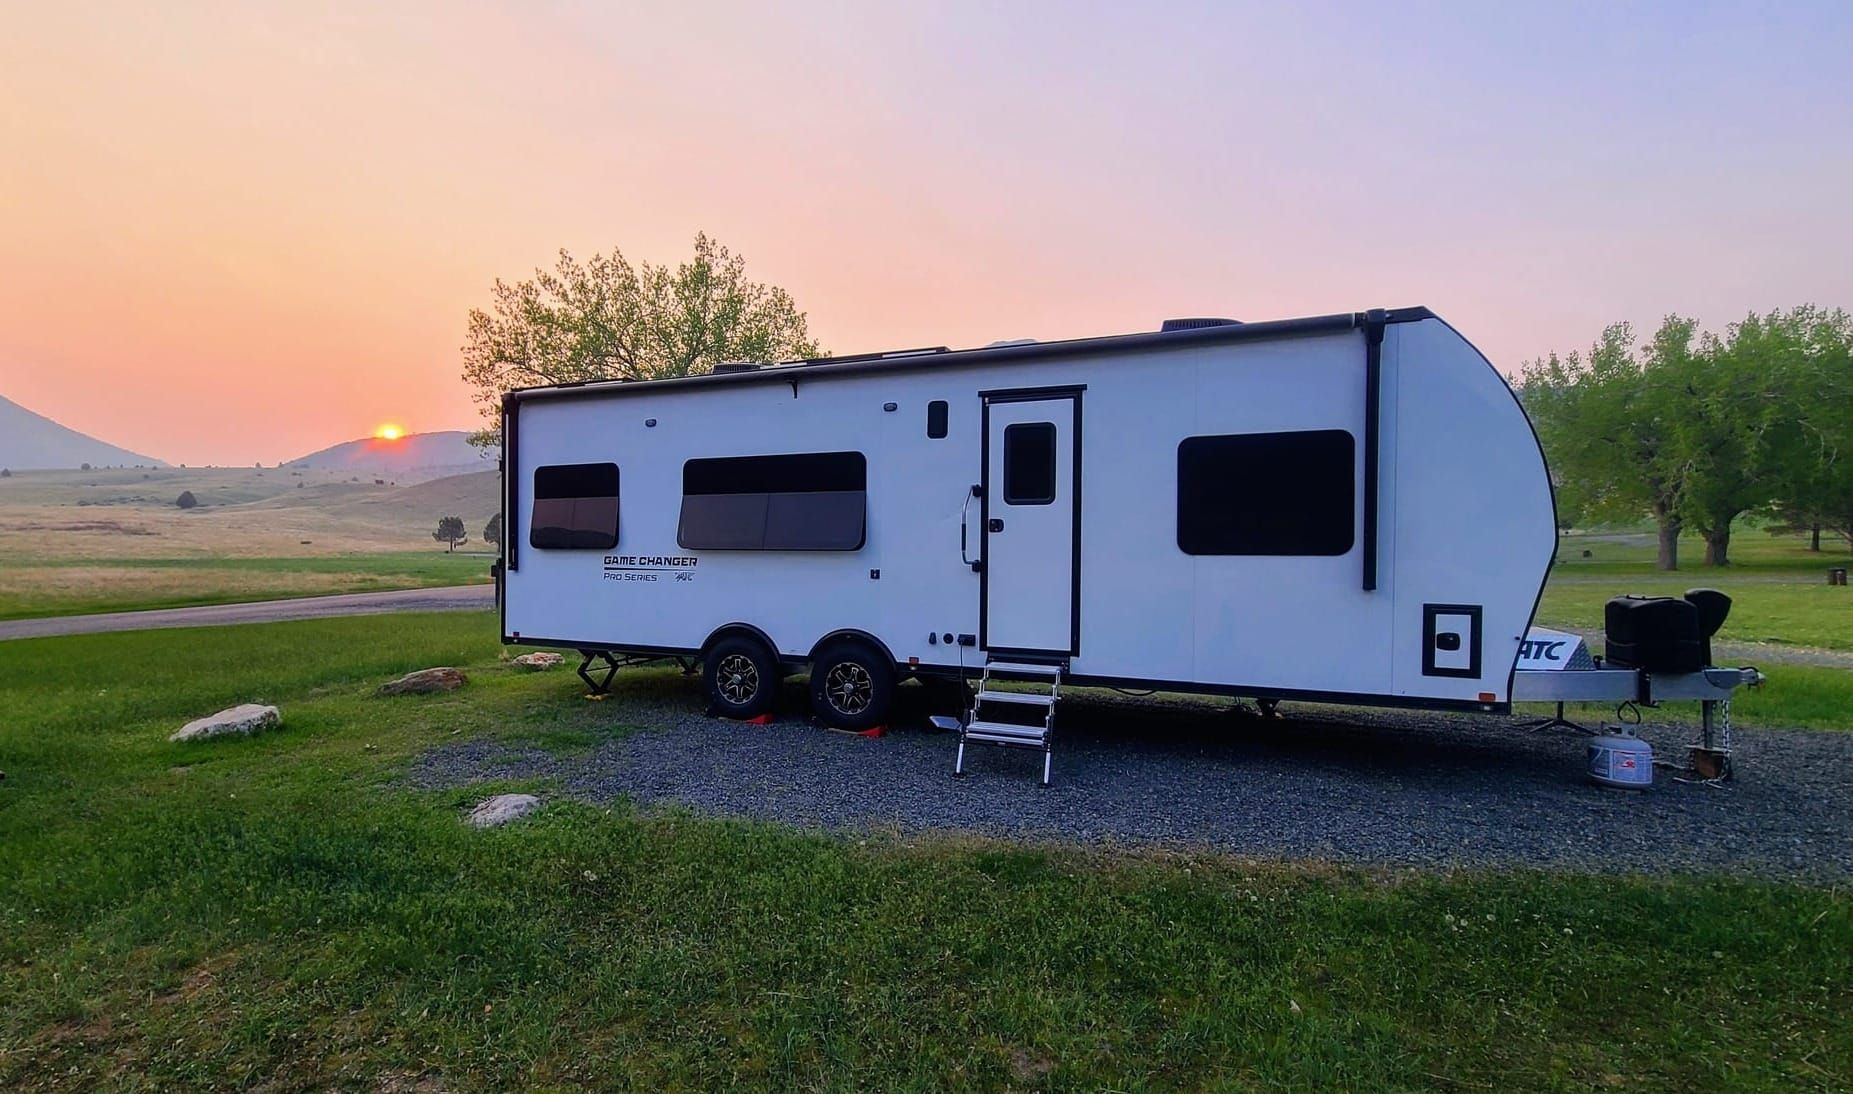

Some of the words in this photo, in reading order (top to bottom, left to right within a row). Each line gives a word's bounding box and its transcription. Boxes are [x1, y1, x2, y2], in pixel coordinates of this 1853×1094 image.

[604, 556, 636, 565] GAME
[638, 556, 697, 566] CHANGER
[603, 572, 622, 581] PRO
[624, 573, 657, 582] SERIES
[1519, 640, 1566, 660] ATC
